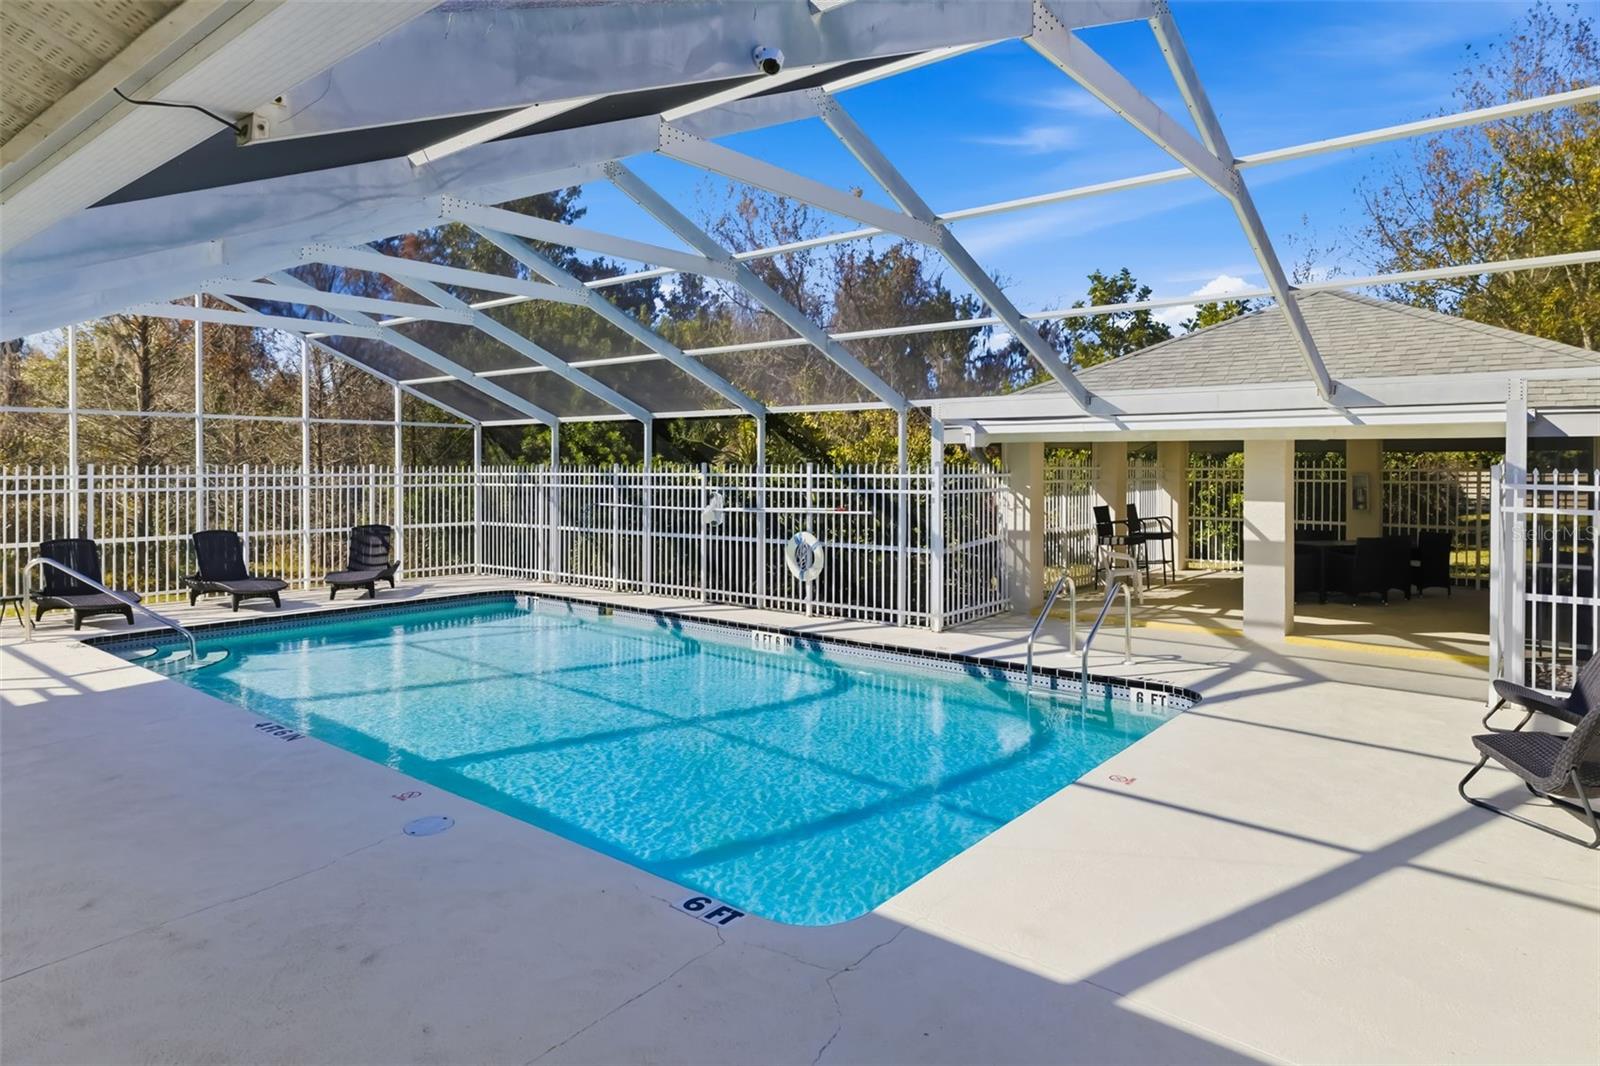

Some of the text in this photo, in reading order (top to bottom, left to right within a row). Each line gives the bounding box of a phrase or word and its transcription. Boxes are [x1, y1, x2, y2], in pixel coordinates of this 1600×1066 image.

[783, 636, 792, 647] IN
[1136, 691, 1167, 707] 6 FT
[683, 896, 746, 926] 6 FT
